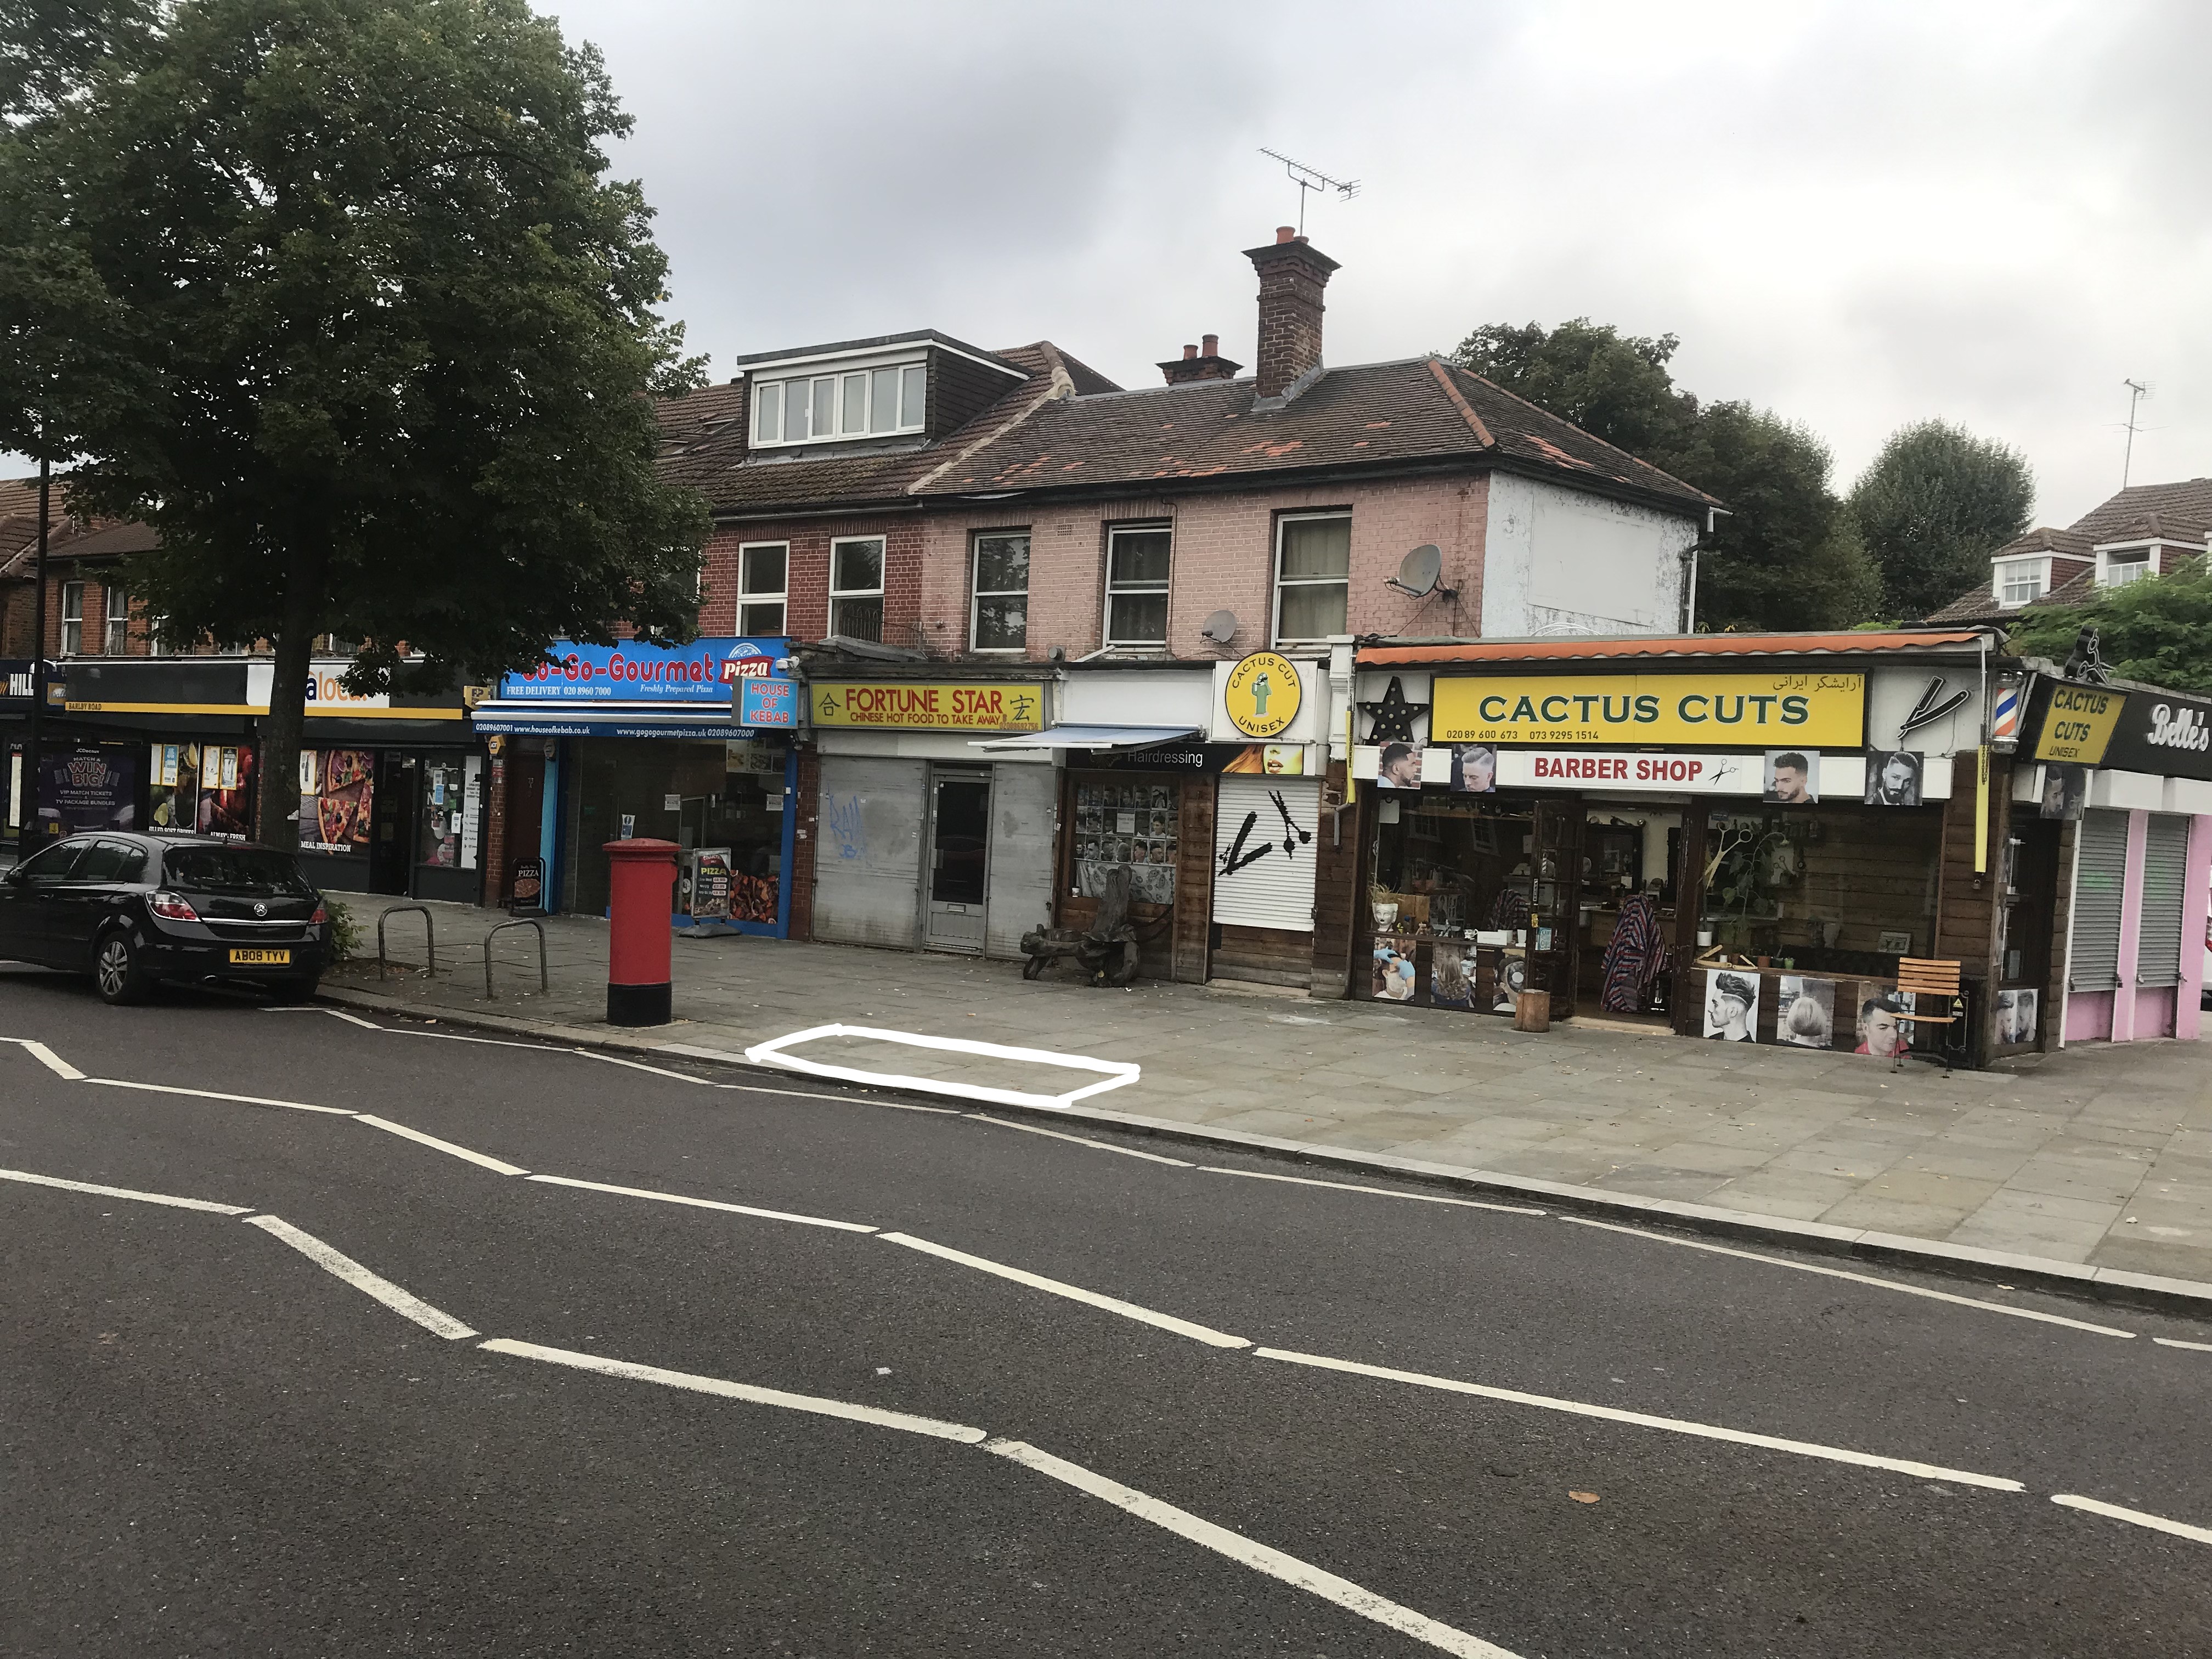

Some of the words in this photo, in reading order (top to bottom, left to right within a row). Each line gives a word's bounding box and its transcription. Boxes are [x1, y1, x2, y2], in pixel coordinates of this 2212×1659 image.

[523, 652, 714, 682] o-Go-Gourmet
[1232, 657, 1275, 689] CACTUS
[1278, 663, 1296, 687] CUT
[9, 674, 33, 696] HILL
[507, 686, 524, 695] FREE
[525, 686, 561, 695] DELIVERY
[563, 686, 576, 695] 020
[577, 687, 593, 696] 8960
[595, 687, 611, 696] 7000
[640, 684, 663, 693] Freshly
[665, 685, 694, 695] Prepared
[696, 685, 713, 693] Pizza
[751, 683, 789, 696] HOUSE
[762, 697, 778, 709] OF
[818, 692, 841, 716] 合
[846, 689, 939, 713] FORTUNE
[952, 690, 1003, 714] STAR
[2055, 689, 2109, 714] CACTUS
[750, 710, 789, 723] KEBAB
[1479, 695, 1660, 724] CACTUS
[1678, 695, 1810, 725] CUTS
[850, 712, 883, 722] CHINESE
[887, 713, 904, 723] HOT
[908, 713, 934, 724] FOOD
[936, 714, 949, 724] TO
[951, 714, 973, 725] TAKE
[977, 715, 1001, 725] AWAY
[1239, 715, 1284, 733] UNISEX
[476, 723, 513, 732] 02089607001
[514, 725, 590, 734] www.houseofkebab.co.uk
[617, 729, 706, 738] www.gogogourmetpizza.uk
[707, 729, 754, 737] 02089607000
[1479, 730, 1496, 738] 600
[1500, 731, 1517, 739] 673
[2054, 721, 2091, 742] CUTS
[2147, 704, 2209, 752] Belle's
[1530, 731, 1547, 740] 073
[1550, 731, 1572, 740] 9295
[1576, 731, 1599, 740] 1514
[1128, 749, 1203, 767] Hairdressing
[2049, 745, 2080, 758] UNISEX
[67, 761, 106, 774] WIN
[1535, 758, 1629, 781] BARBER
[1635, 759, 1703, 782] SHOP
[72, 773, 104, 787] BIG!
[301, 840, 315, 849] MEAL
[316, 842, 351, 853] INSPIRATION
[235, 950, 263, 961] AB08
[266, 951, 285, 961] TYV
